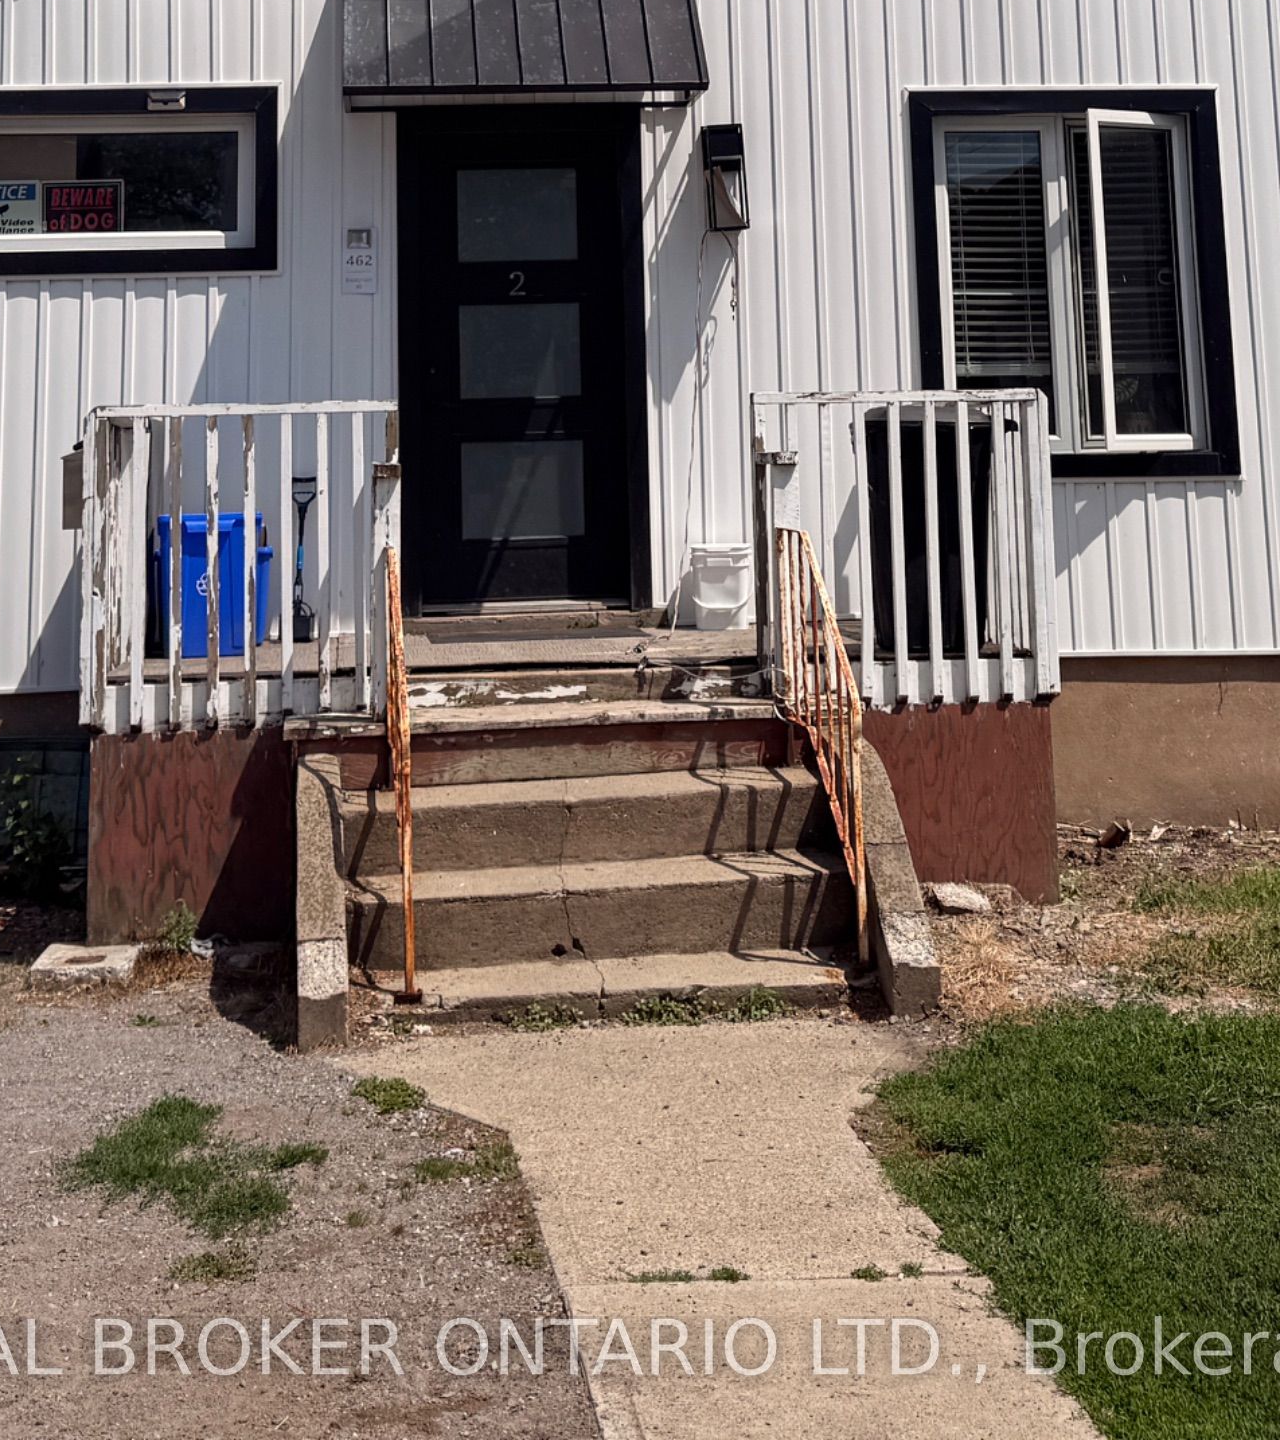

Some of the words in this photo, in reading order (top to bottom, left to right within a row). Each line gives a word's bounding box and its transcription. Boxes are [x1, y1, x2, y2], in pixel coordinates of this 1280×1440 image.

[51, 187, 114, 208] BEWARE
[50, 214, 66, 231] of
[70, 212, 114, 230] DOG
[346, 255, 373, 266] 462
[509, 271, 526, 296] 2
